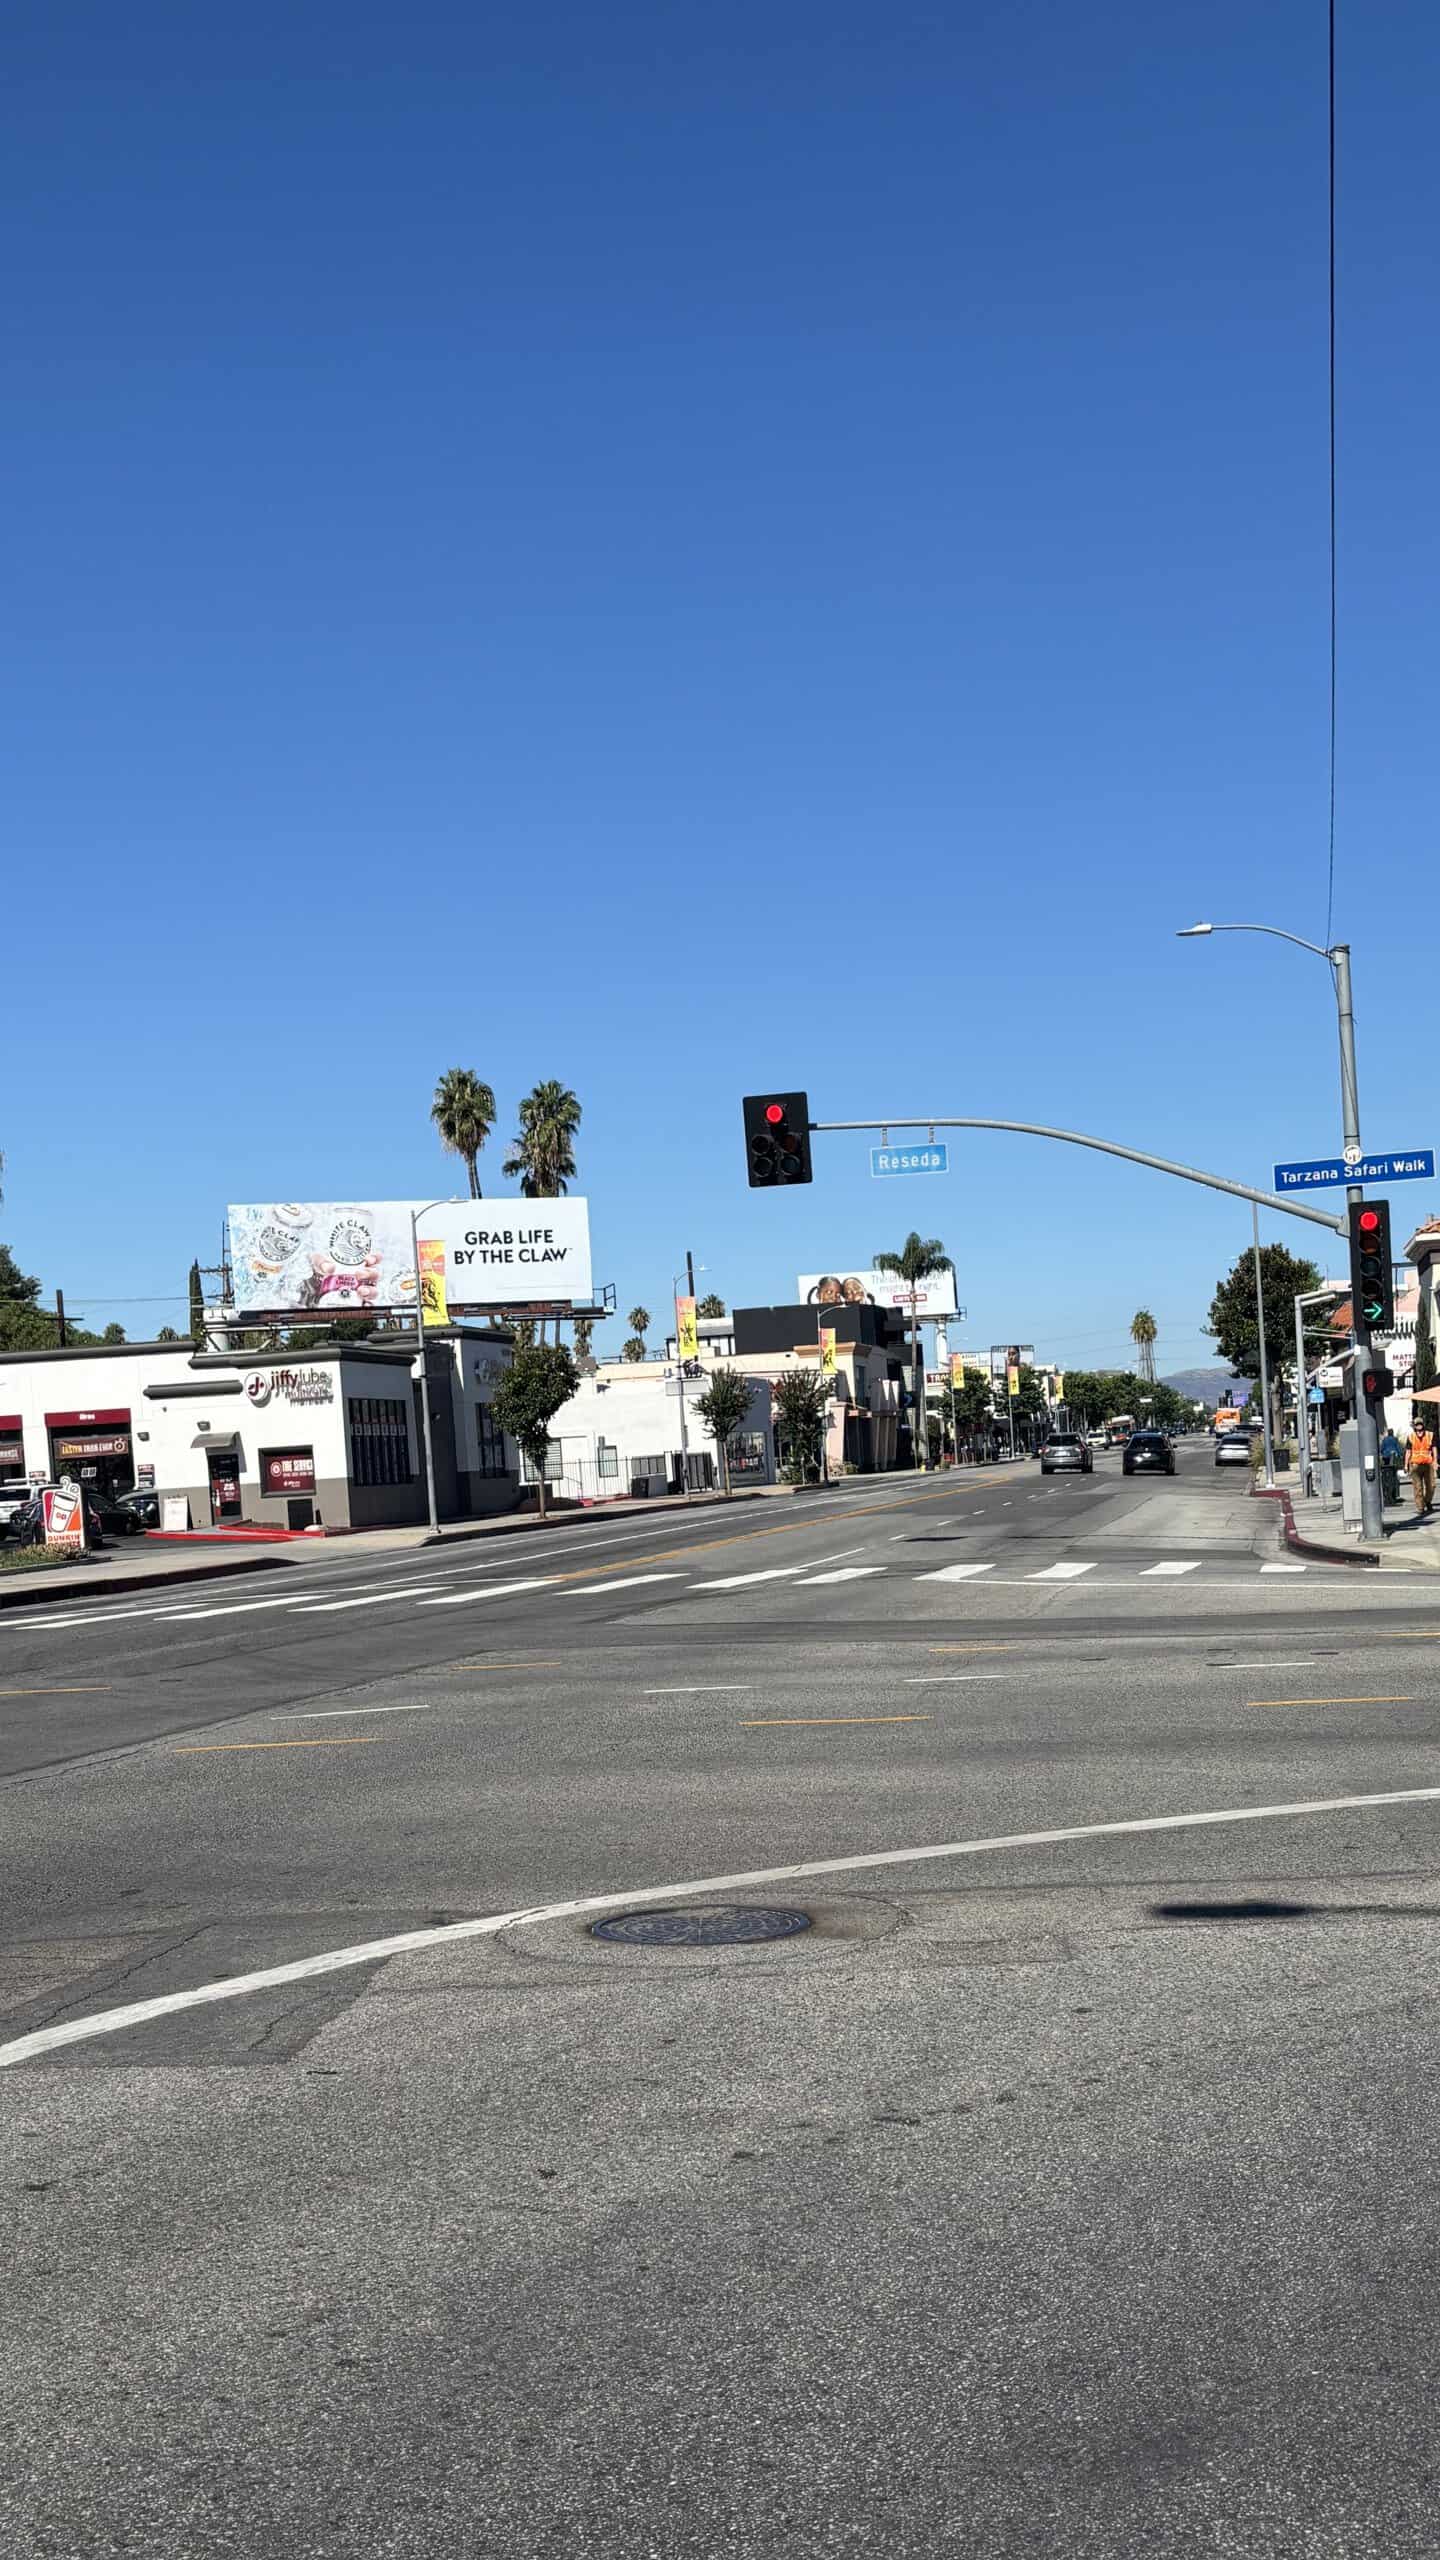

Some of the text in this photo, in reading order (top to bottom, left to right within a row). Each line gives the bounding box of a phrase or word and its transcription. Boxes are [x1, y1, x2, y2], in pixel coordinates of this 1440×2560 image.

[879, 1152, 940, 1169] Reseda
[1281, 1159, 1426, 1184] Tarzana Safari Walk
[347, 1219, 371, 1237] CLAW
[464, 1229, 554, 1245] GRAB LIFE
[454, 1251, 475, 1265] BY
[480, 1249, 514, 1264] THE
[518, 1247, 567, 1263] CLAW
[270, 1367, 328, 1391] jiffy lube
